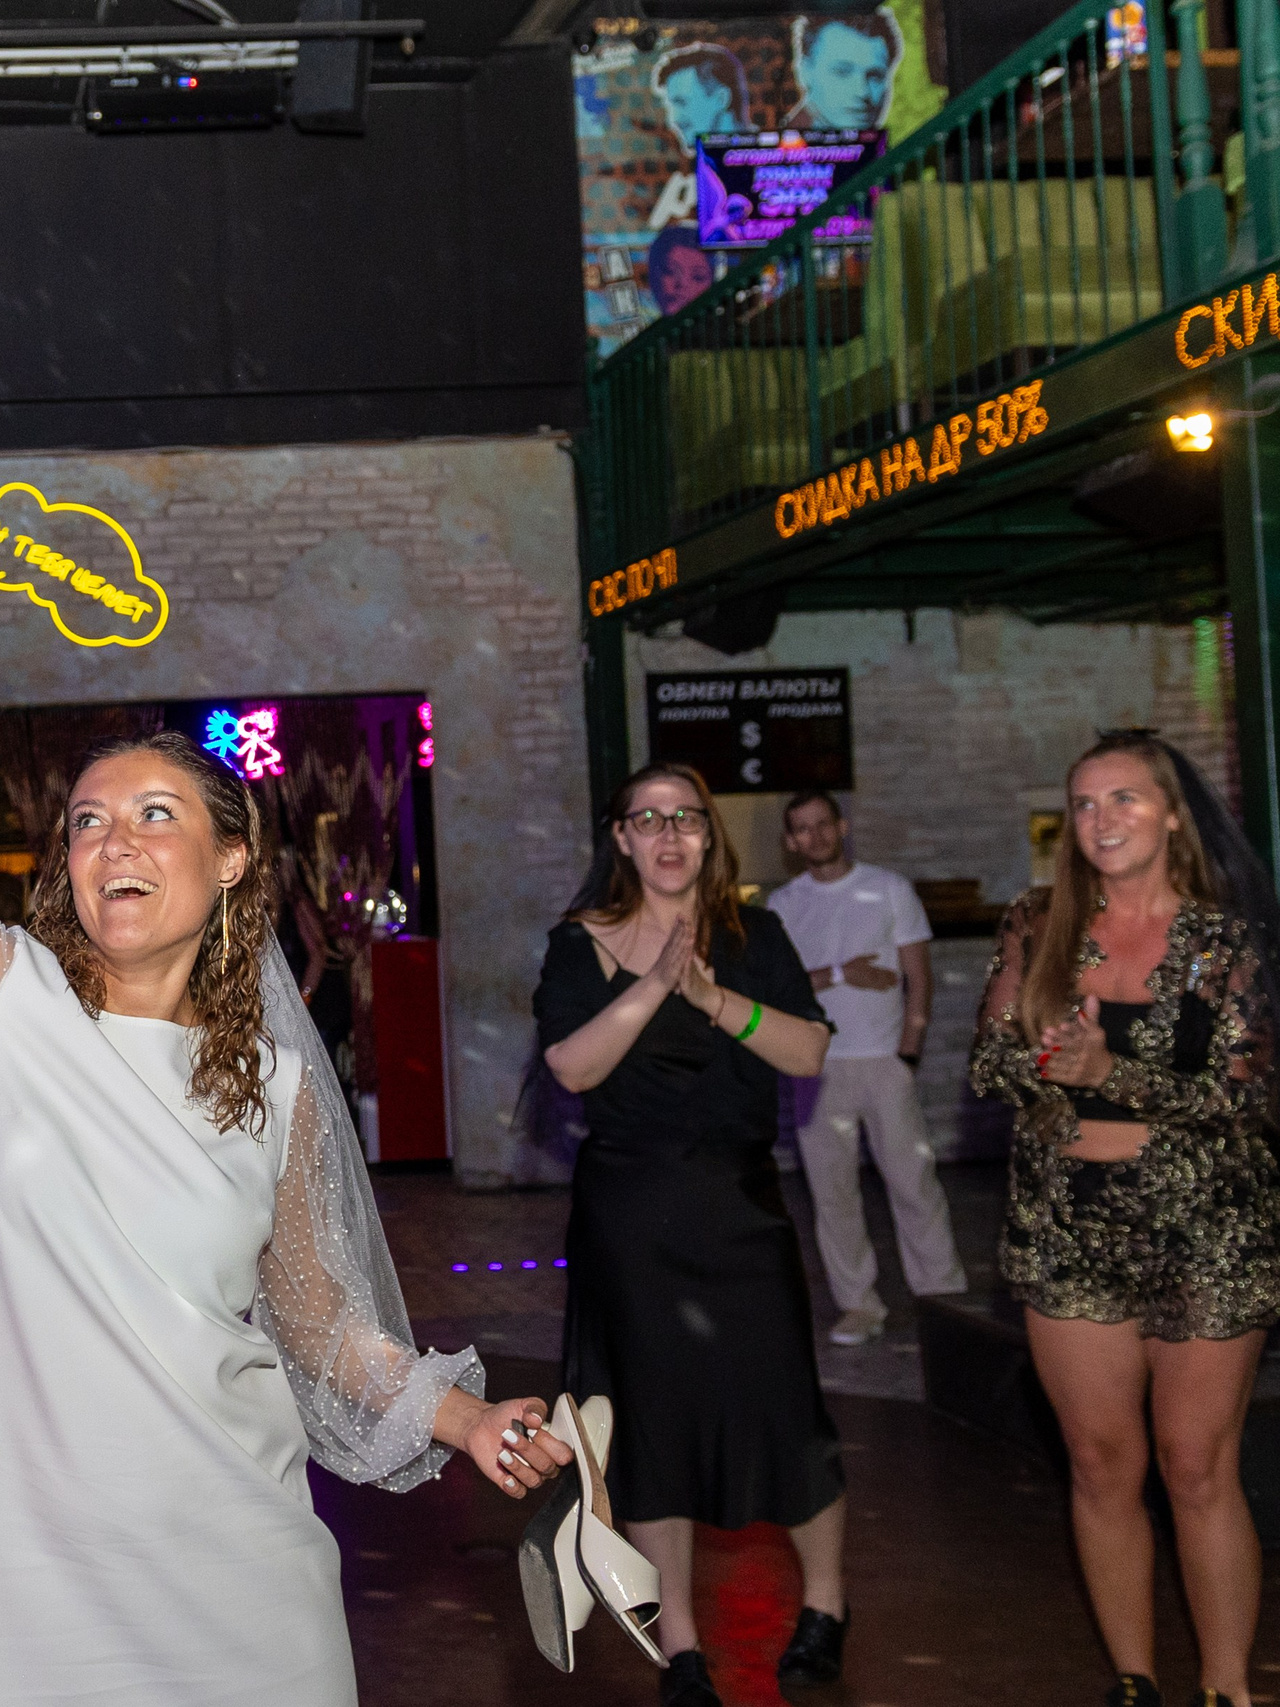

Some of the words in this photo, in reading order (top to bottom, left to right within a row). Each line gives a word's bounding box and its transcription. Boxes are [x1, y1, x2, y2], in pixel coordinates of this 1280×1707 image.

[1175, 273, 1280, 369] СКИ
[774, 457, 880, 539] СКИДКА
[880, 436, 927, 497] НА
[927, 413, 973, 484] ДР
[976, 378, 1050, 456] 50%
[14, 535, 76, 581] ТЕБЯ
[656, 682, 735, 701] ОБМЕН
[739, 678, 841, 699] ВАЛЮТЫ
